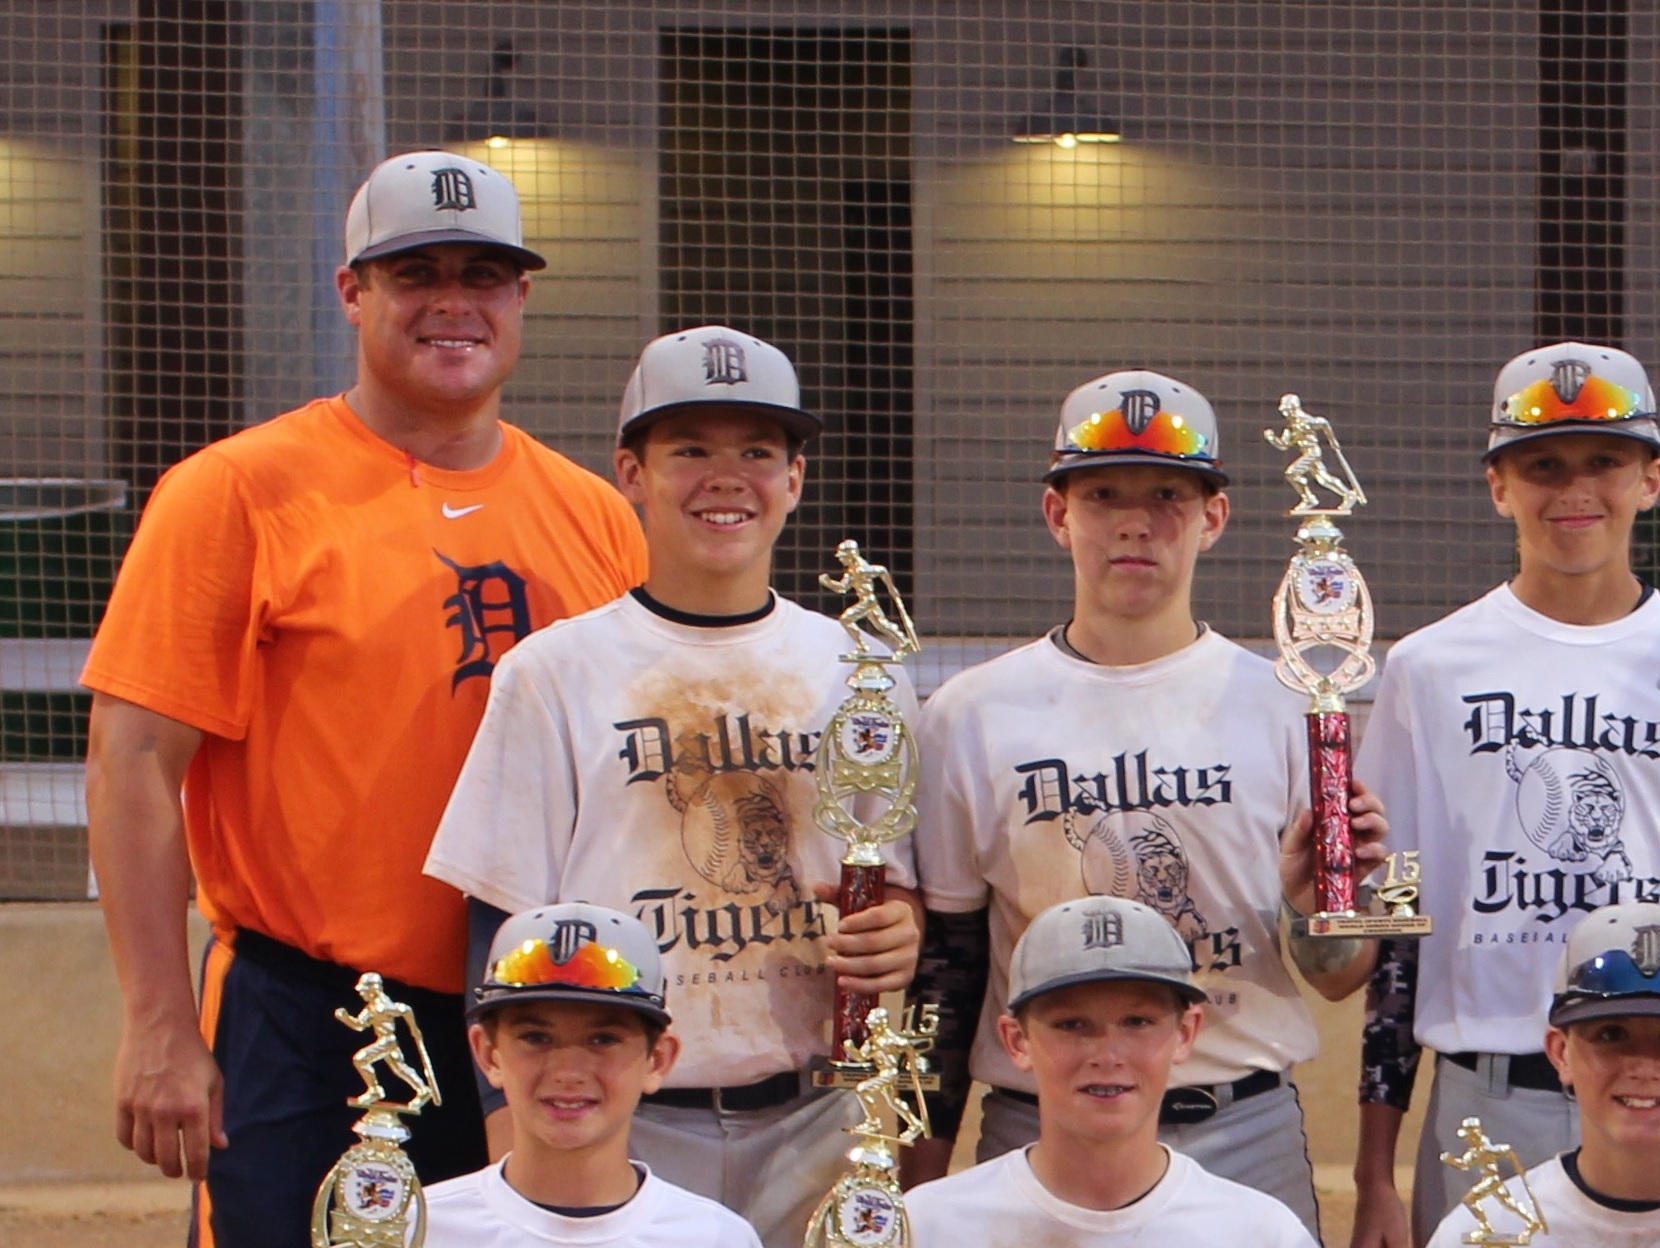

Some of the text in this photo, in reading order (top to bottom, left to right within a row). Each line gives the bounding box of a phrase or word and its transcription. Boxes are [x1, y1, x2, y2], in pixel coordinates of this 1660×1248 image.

[431, 167, 477, 212] D
[703, 337, 747, 385] D
[1549, 359, 1592, 404] D
[1118, 389, 1161, 436] D
[432, 547, 532, 699] D
[1014, 749, 1232, 826] Dallas
[1385, 851, 1420, 886] 15
[630, 888, 827, 963] Tigers
[1081, 909, 1124, 950] D
[1474, 932, 1568, 944] BASEAL
[676, 970, 765, 986] SEBALL
[902, 1004, 940, 1036] 15
